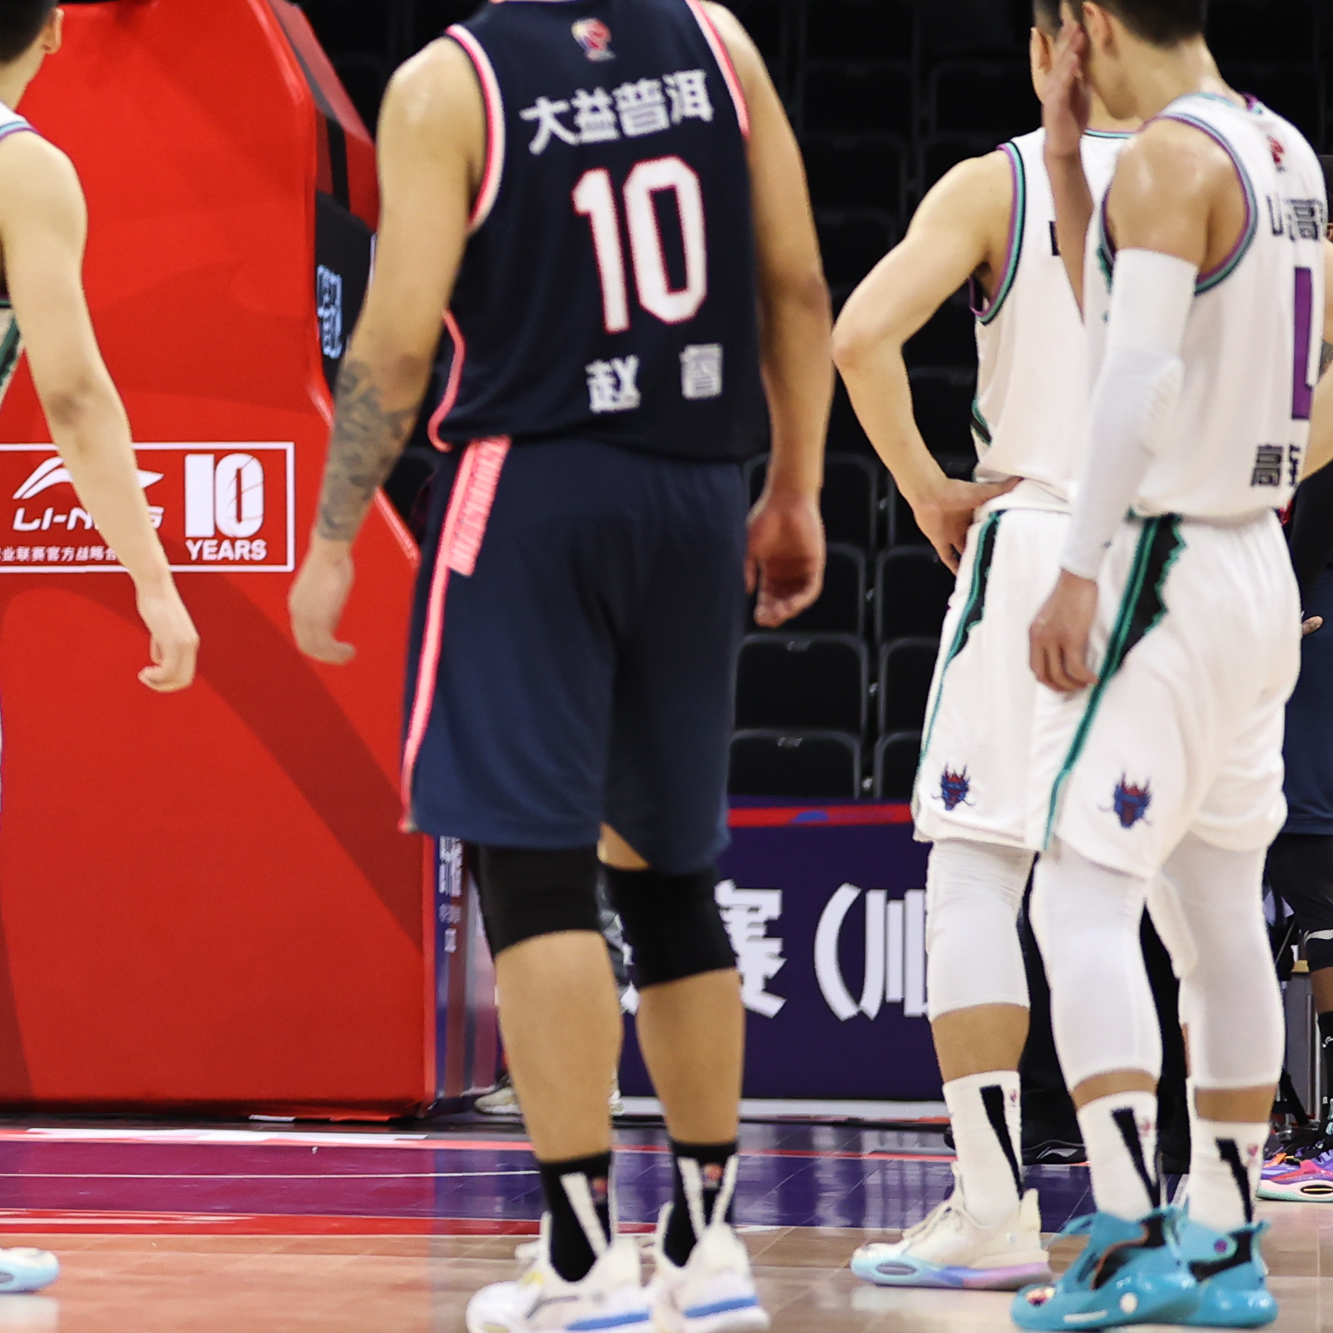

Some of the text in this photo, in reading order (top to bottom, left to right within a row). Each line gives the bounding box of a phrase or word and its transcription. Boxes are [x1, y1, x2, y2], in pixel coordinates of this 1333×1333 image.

[519, 68, 714, 155] 大益普洱
[571, 154, 709, 335] 10
[185, 453, 265, 538] 10
[185, 539, 268, 561] YEARS
